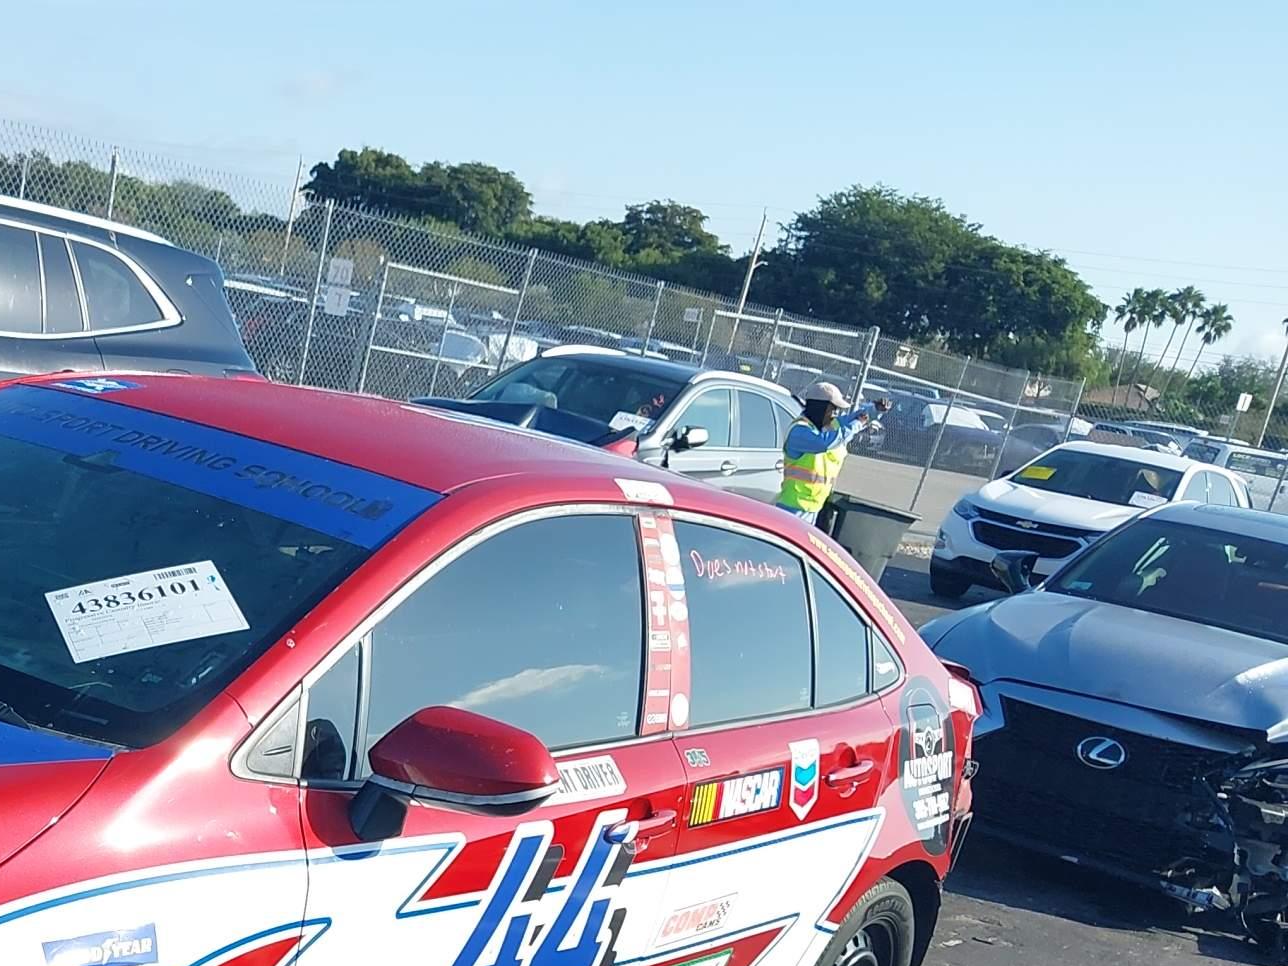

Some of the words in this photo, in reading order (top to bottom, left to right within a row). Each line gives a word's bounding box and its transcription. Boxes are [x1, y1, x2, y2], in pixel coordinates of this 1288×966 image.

[113, 429, 236, 471] DRIVING
[234, 463, 370, 514] SCHOOL
[71, 578, 201, 615] 43836101
[573, 762, 619, 790] DRIVER
[903, 750, 953, 789] AUTOSPORT
[718, 769, 781, 819] NASCAR
[661, 903, 719, 937] COMP
[695, 919, 720, 932] CAMS
